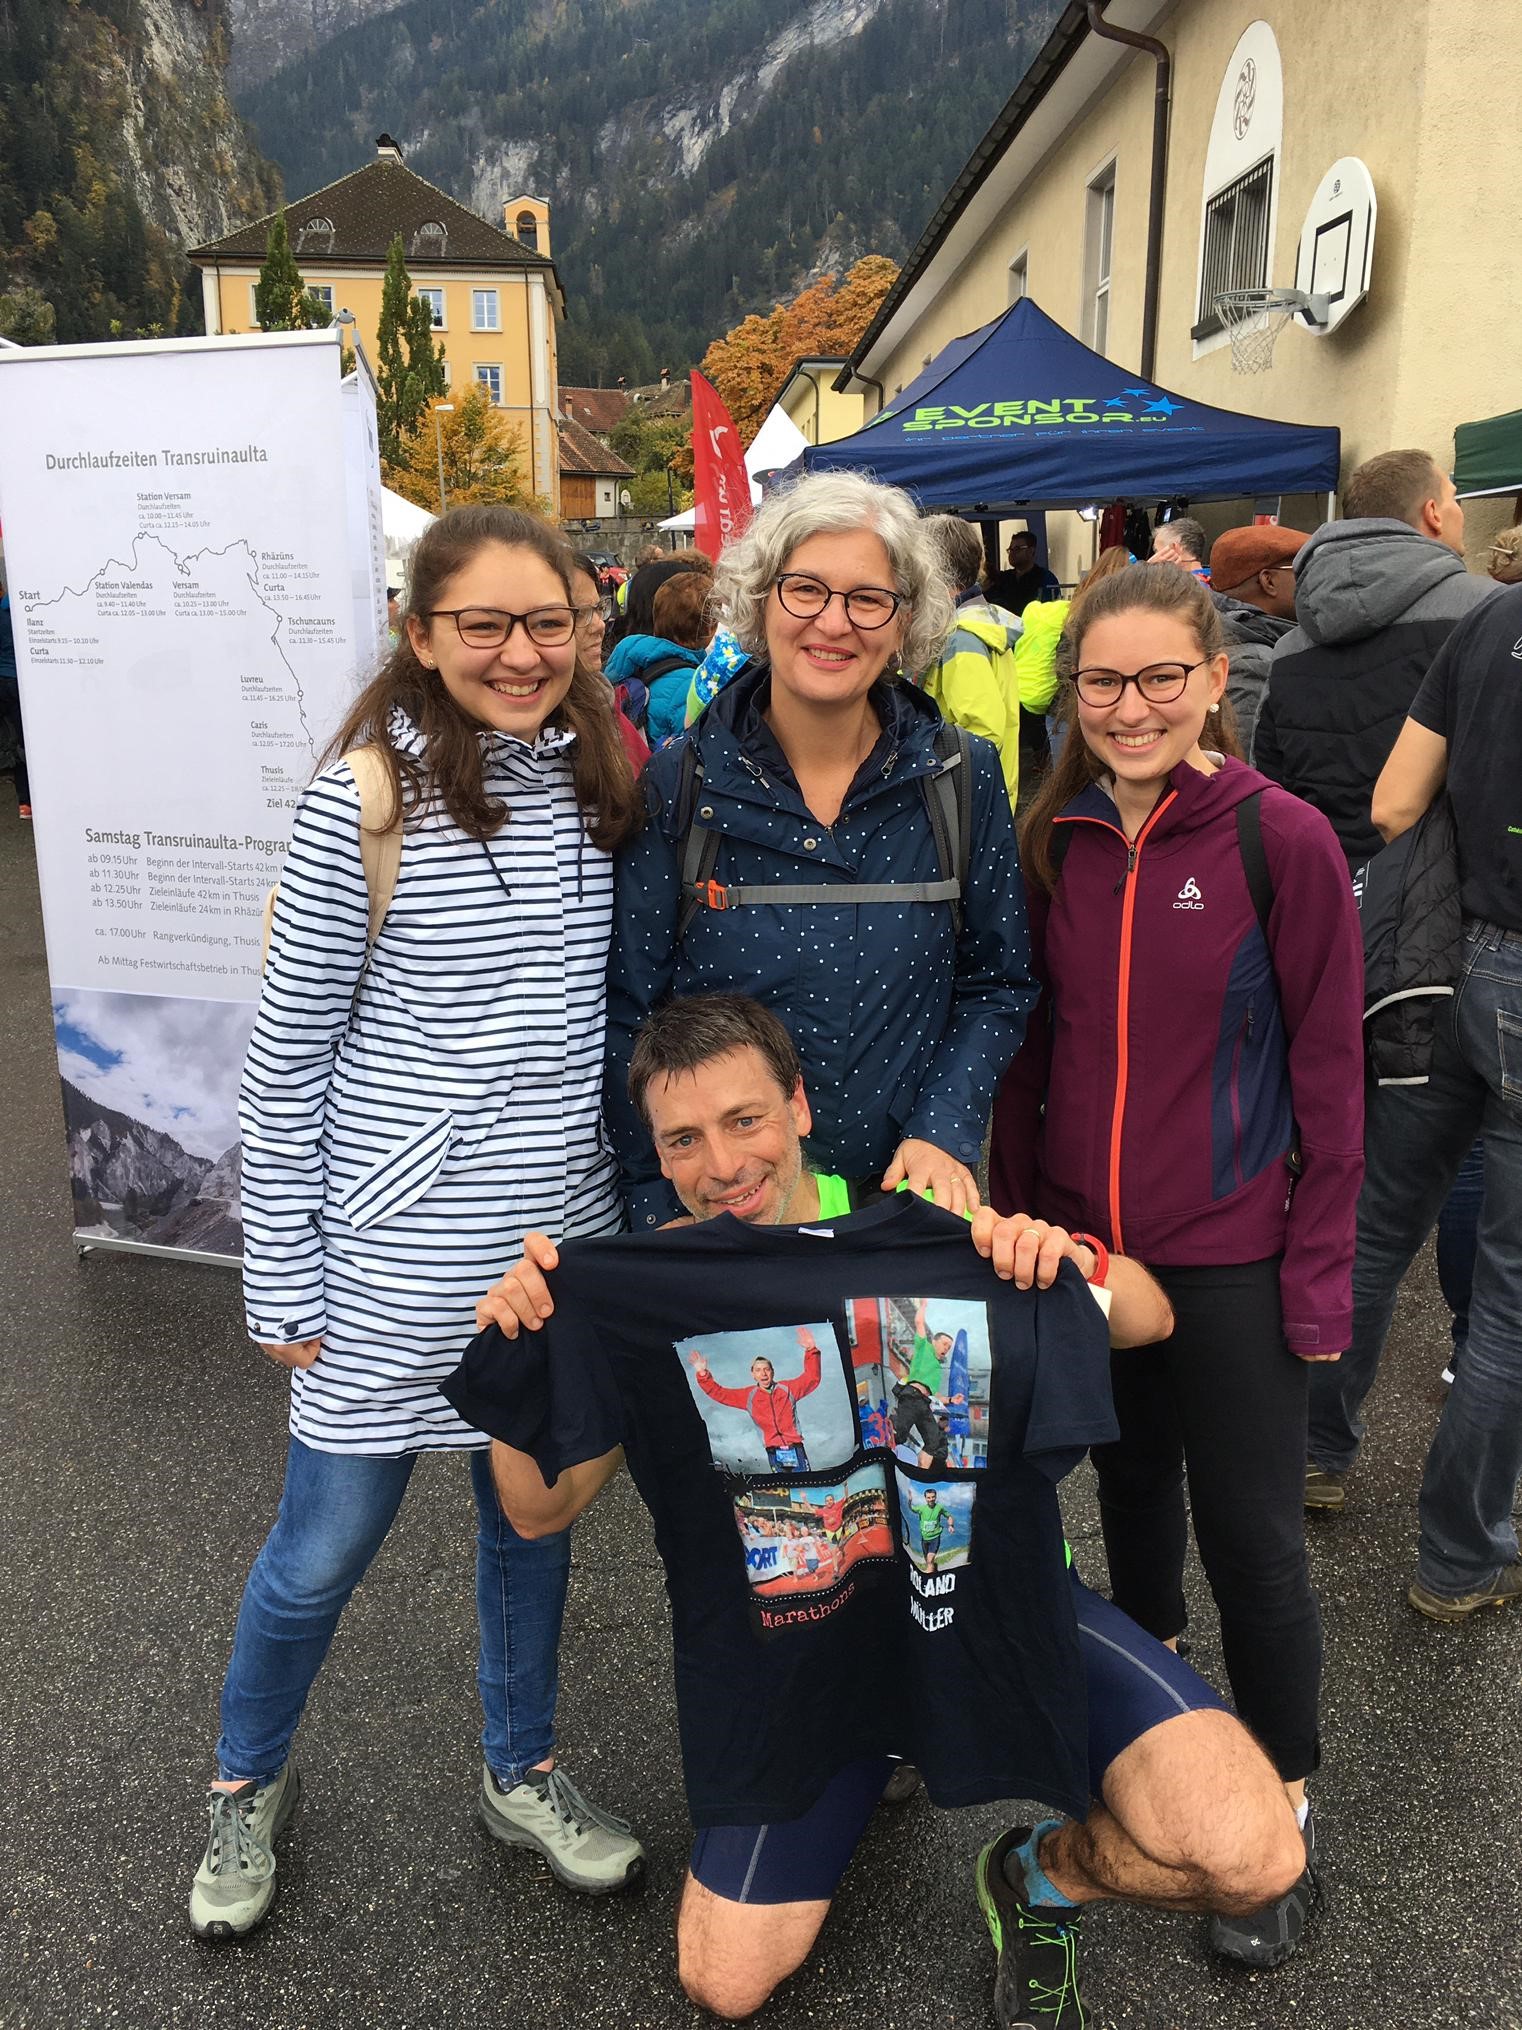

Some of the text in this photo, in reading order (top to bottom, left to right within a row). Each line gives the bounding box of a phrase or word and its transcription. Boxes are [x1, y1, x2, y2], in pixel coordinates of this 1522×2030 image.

[915, 398, 1097, 420] EVENT
[46, 444, 268, 470] Durchlaufzeiten Transruinaulta
[136, 492, 192, 501] Station Versam
[262, 552, 294, 560] Rhäzüns
[94, 580, 153, 590] Station Valendas
[172, 580, 200, 590] Versam
[264, 584, 286, 592] Curta
[19, 590, 40, 600] Start
[30, 647, 50, 655] Curta
[250, 720, 268, 729] Cazis
[260, 765, 284, 774] Thusis
[266, 798, 283, 809] Ziel
[86, 828, 142, 850] Samstag
[88, 853, 98, 863] ab
[146, 856, 174, 869] Beginn
[176, 858, 190, 868] der
[192, 860, 254, 872] Intervall-Starts
[90, 868, 100, 878] ab
[148, 871, 176, 884] Beginn
[178, 872, 191, 884] der
[193, 874, 255, 886] Intervall-Starts
[91, 882, 102, 892] ab
[150, 886, 196, 898] Zieleinläufe
[222, 891, 231, 901] in
[232, 891, 260, 902] Thusis
[92, 897, 103, 908] ab
[150, 901, 196, 914] Zieleinläufe
[224, 905, 232, 916] in
[1172, 900, 1204, 910] odlo
[95, 927, 108, 936] ca.
[153, 930, 231, 948] Rangverkündigung,
[234, 936, 261, 946] Thusis
[98, 955, 110, 966] Ab
[112, 956, 138, 970] Mittag
[140, 958, 228, 976] Festwirtschaftsbetrieb
[230, 964, 240, 976] in
[760, 1582, 856, 1629] Marathons
